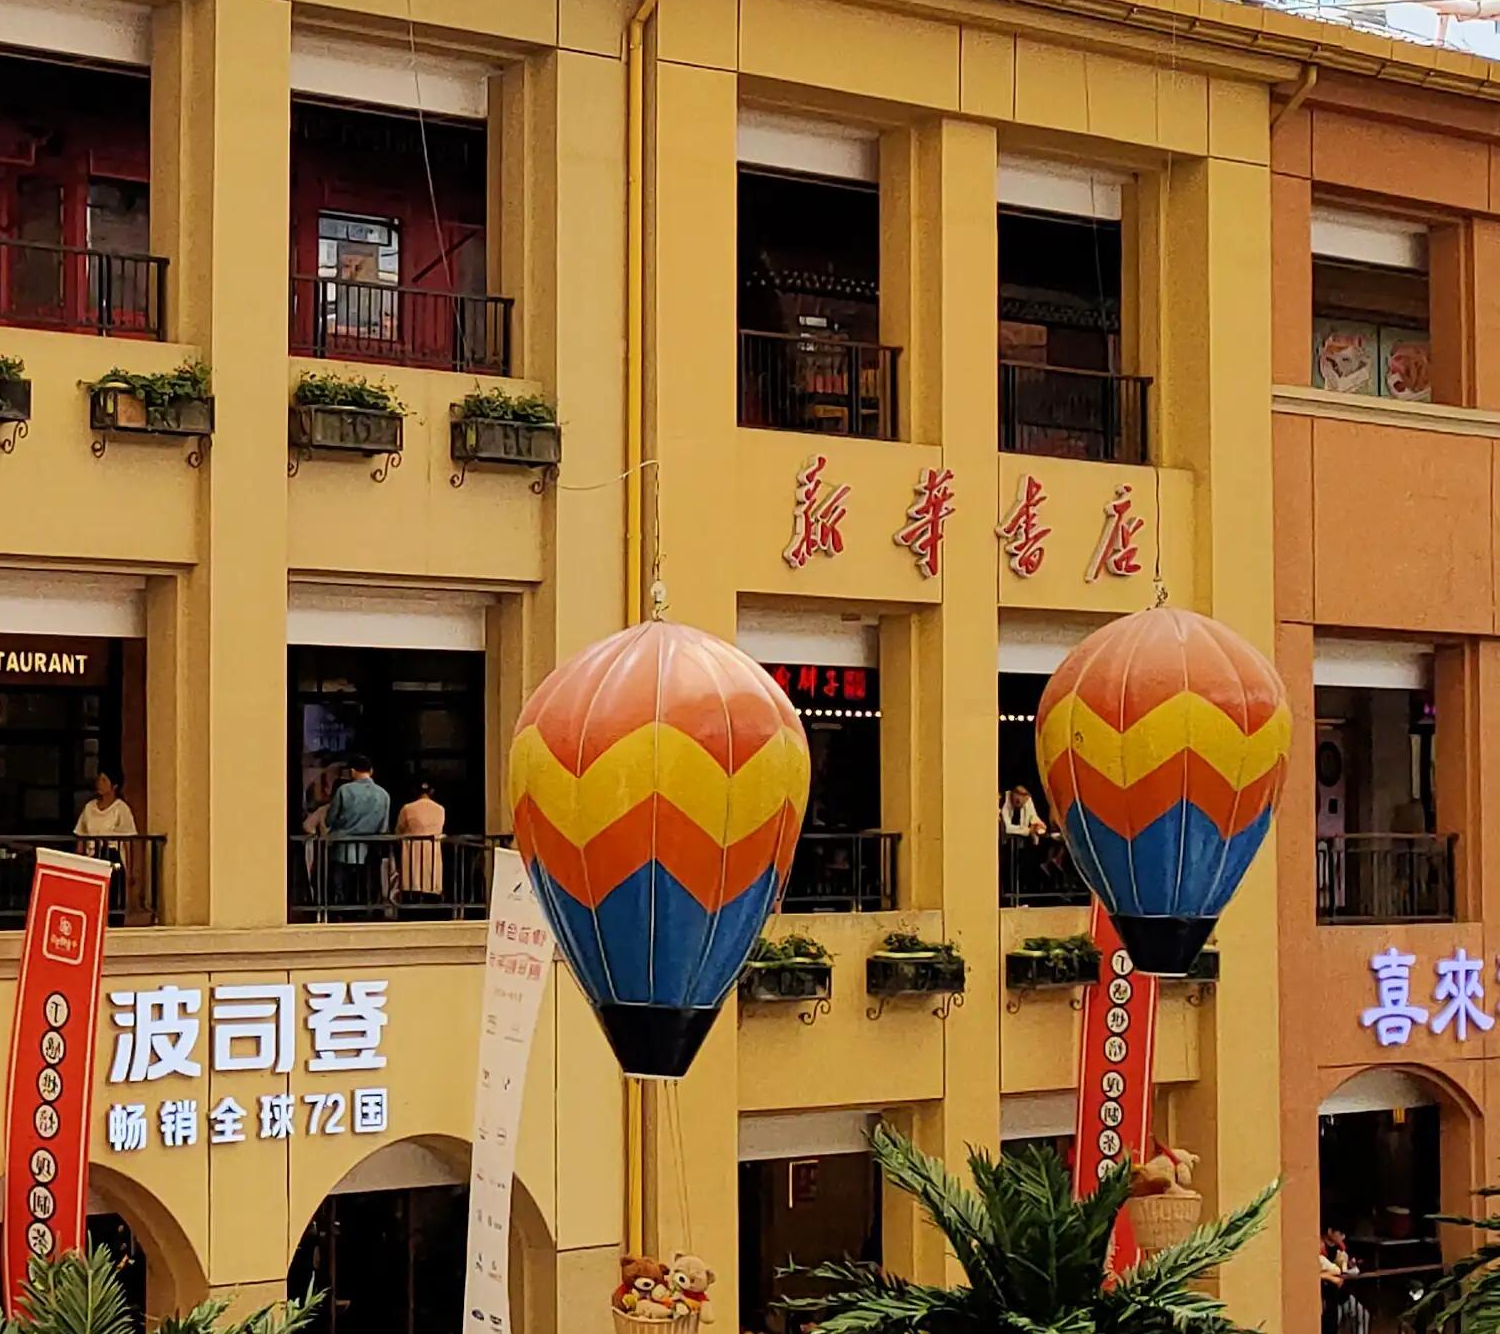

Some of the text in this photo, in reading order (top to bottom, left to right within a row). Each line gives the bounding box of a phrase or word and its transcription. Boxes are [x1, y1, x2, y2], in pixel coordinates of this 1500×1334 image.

[109, 980, 389, 1084] 波司登
[1361, 947, 1500, 1047] 喜來
[108, 1088, 389, 1152] 畅销全球72国
